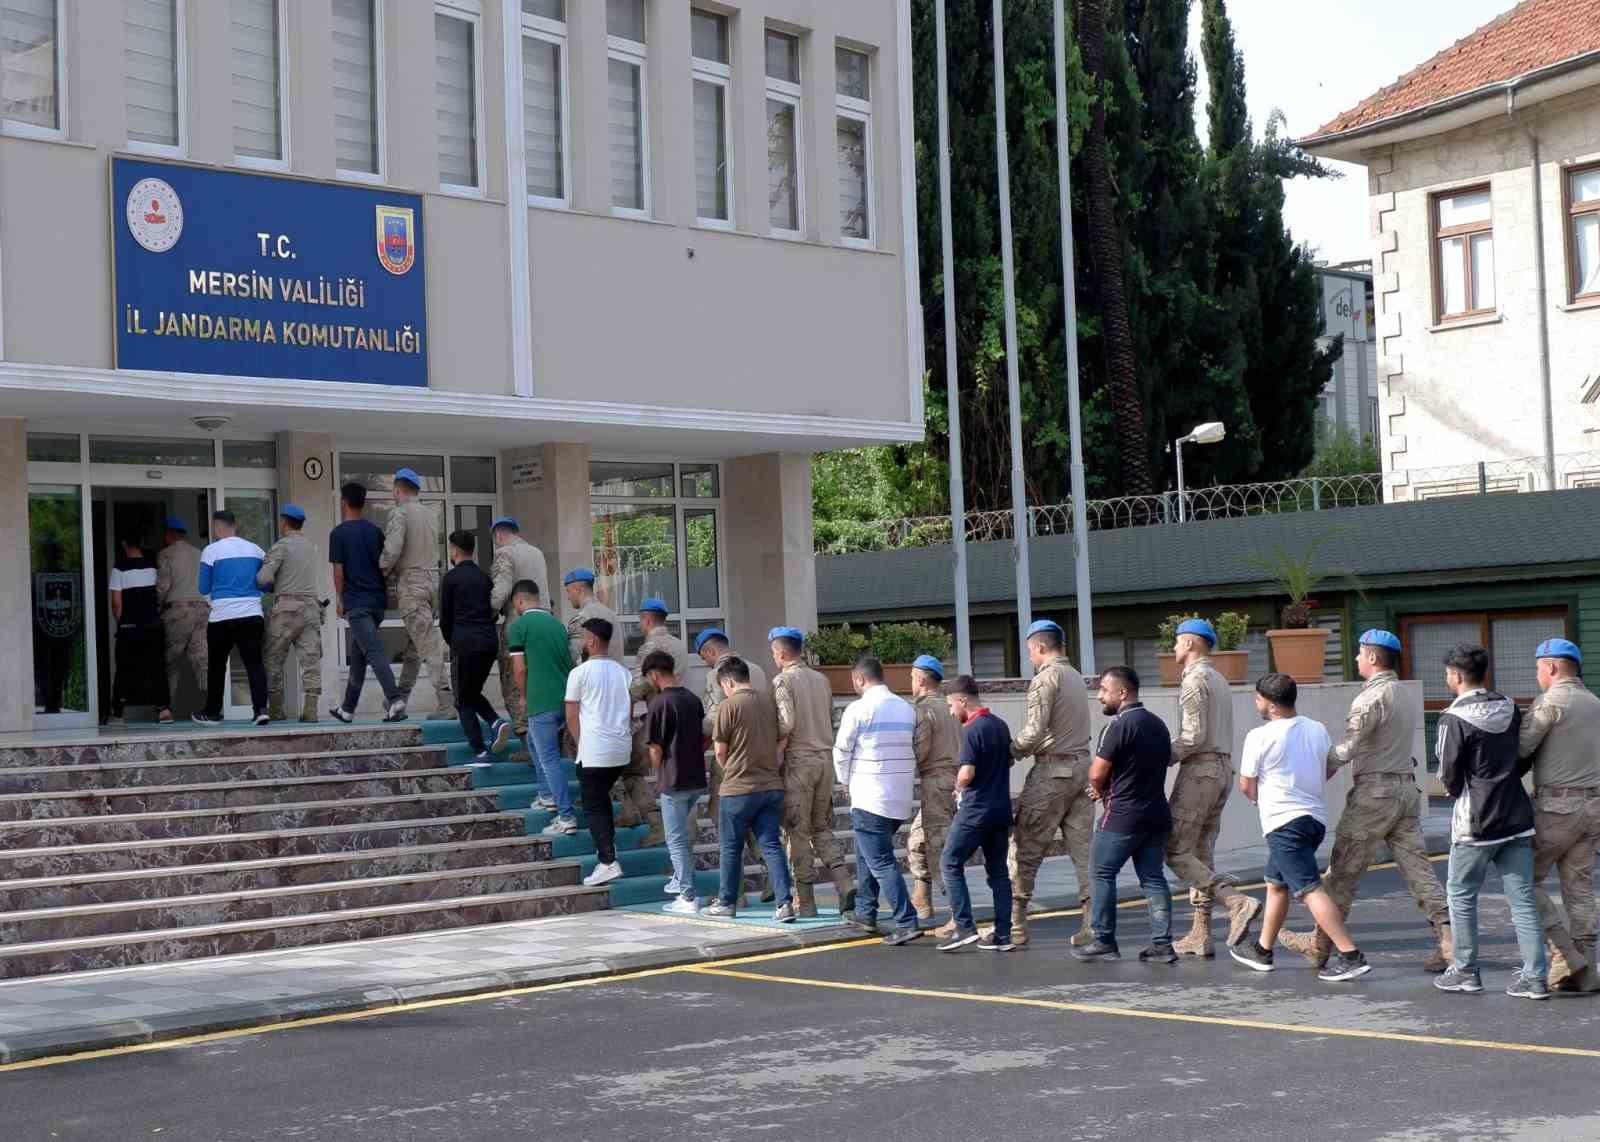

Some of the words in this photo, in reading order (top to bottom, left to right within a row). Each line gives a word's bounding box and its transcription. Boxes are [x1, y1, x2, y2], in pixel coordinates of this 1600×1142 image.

[257, 232, 297, 259] T.C.
[189, 269, 273, 300] MERSİN
[279, 275, 365, 308] VALİLİĞİ
[126, 304, 147, 334] İL
[153, 311, 277, 344] JANDARMA
[282, 321, 421, 354] KOMUTANLIĞI
